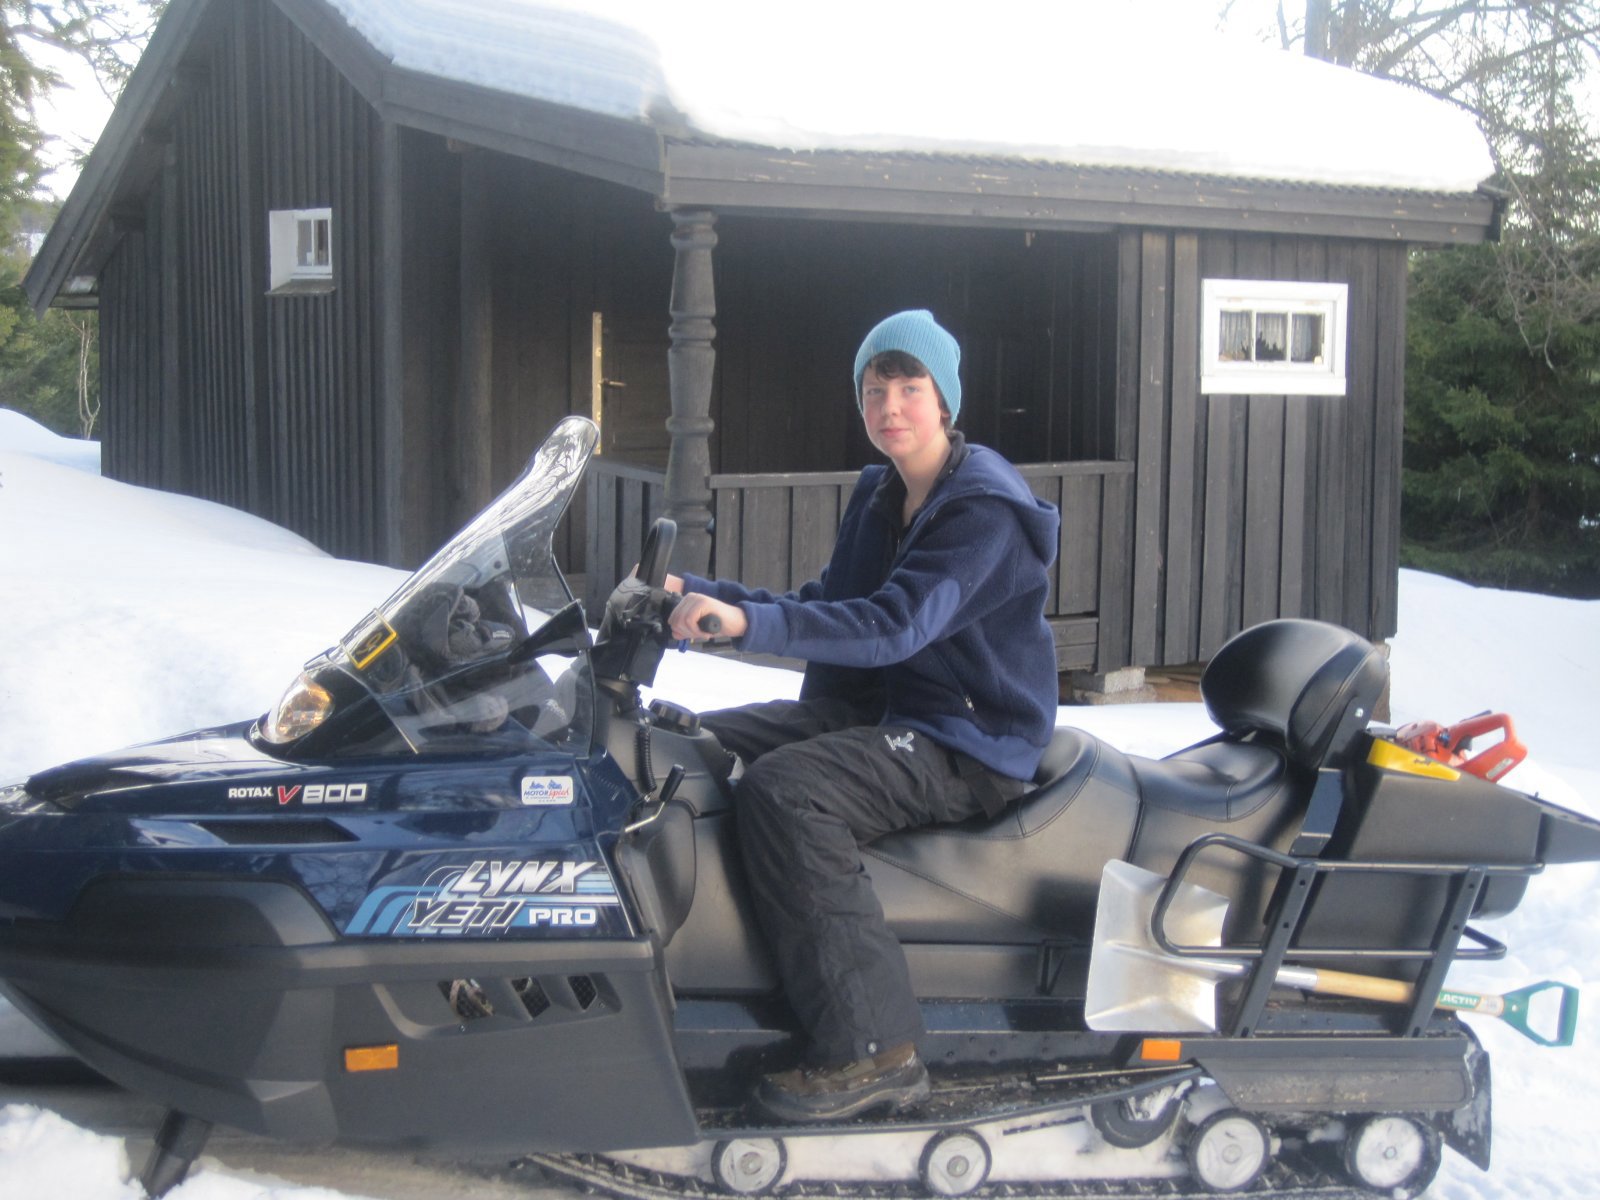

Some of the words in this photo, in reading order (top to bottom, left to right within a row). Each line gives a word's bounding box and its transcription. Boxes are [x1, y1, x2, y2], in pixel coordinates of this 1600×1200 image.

[228, 787, 273, 798] ROTAX
[449, 860, 597, 896] LYNX
[407, 898, 526, 927] YETI
[528, 908, 597, 925] PRO
